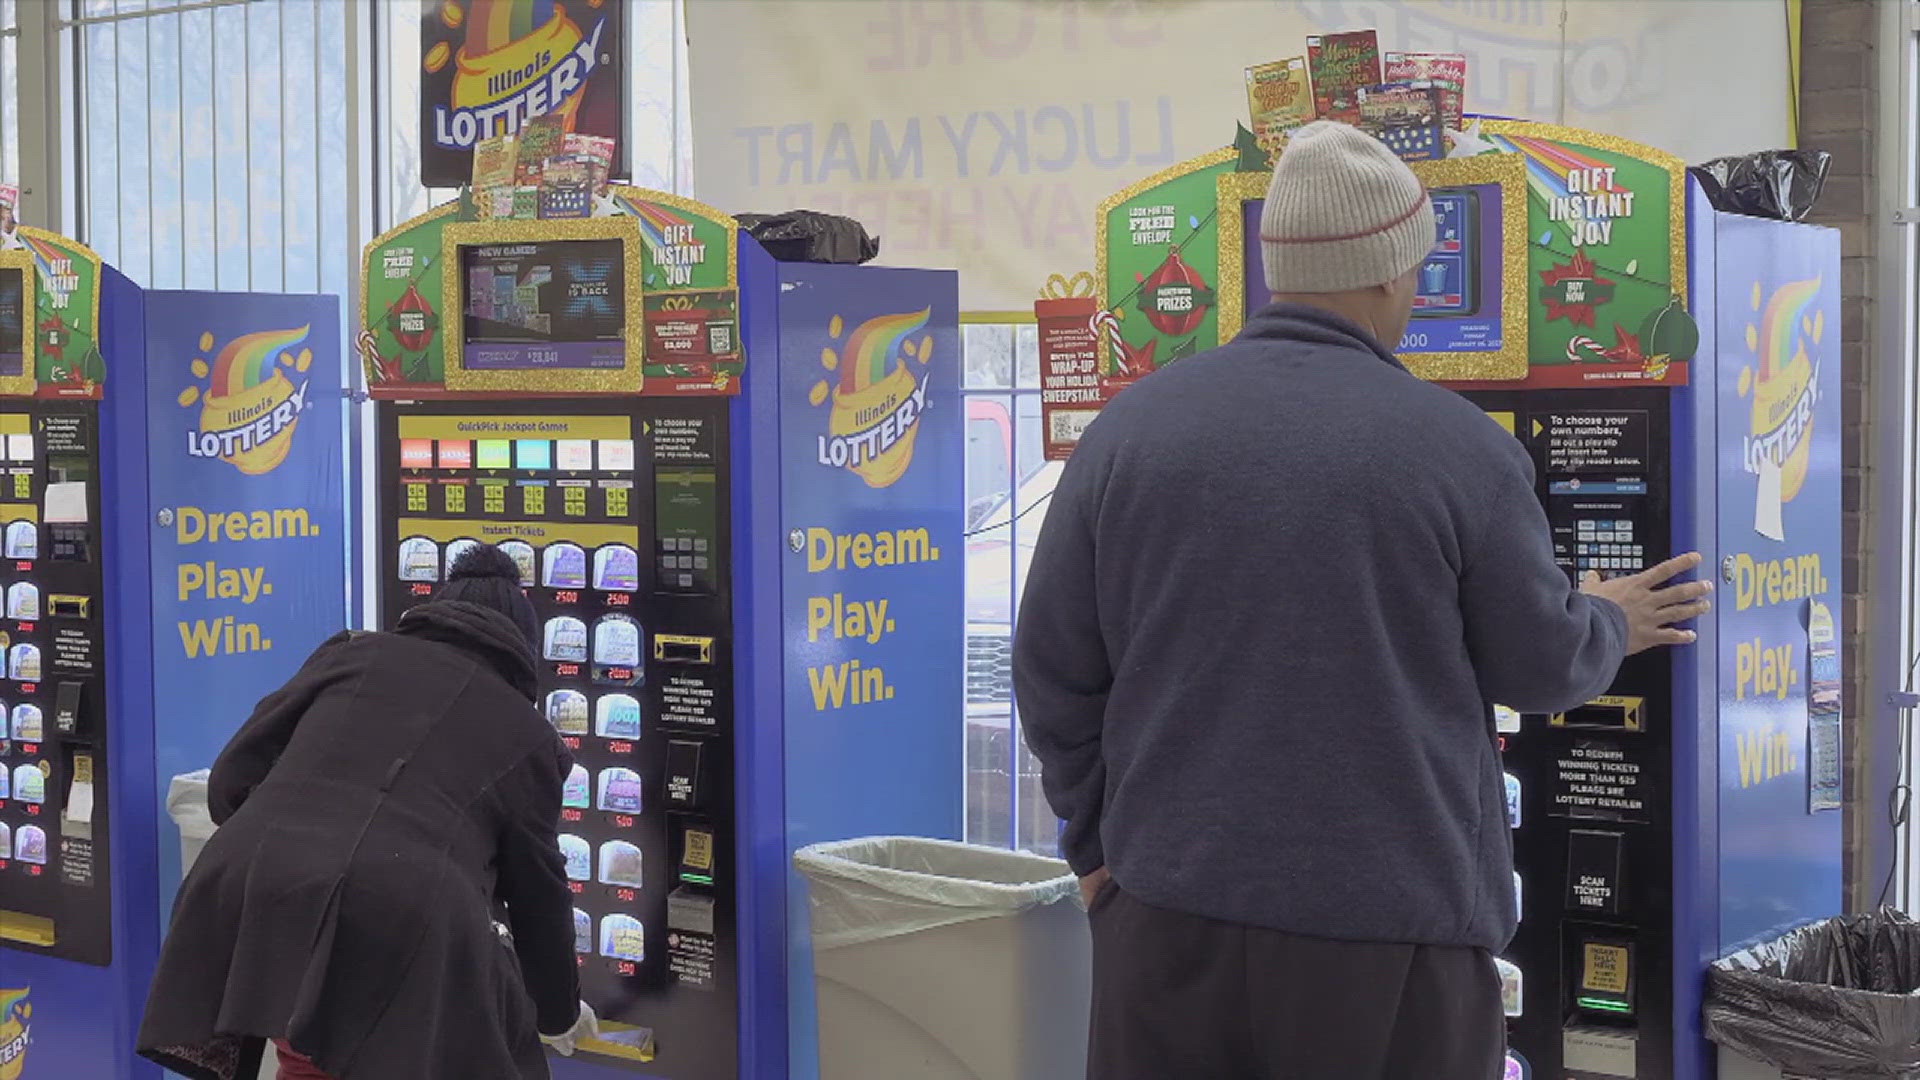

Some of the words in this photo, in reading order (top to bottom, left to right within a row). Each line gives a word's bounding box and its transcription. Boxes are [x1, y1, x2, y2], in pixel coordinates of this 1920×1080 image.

[435, 19, 606, 146] LOTTERY
[488, 49, 551, 97] Illinois
[1568, 166, 1616, 193] GIFT
[1550, 192, 1634, 221] INSTANT
[664, 224, 694, 245] GIFT
[1571, 220, 1613, 247] JOY
[653, 245, 706, 265] INSTANT
[666, 265, 693, 285] JOY
[1157, 296, 1192, 311] PRIZES
[1051, 360, 1094, 374] WRAP-UP
[1045, 376, 1065, 388] YOUR
[1066, 374, 1100, 387] HOLIDA
[855, 392, 897, 426] Illinois
[1042, 388, 1101, 403] SWEEPSTAKE
[187, 379, 309, 458] LOTTERY
[227, 396, 273, 424] Illinois
[817, 372, 930, 467] LOTTERY
[1551, 415, 1563, 425] To
[1565, 415, 1602, 425] choose
[1604, 416, 1628, 426] your
[1743, 355, 1821, 475] LOTTERY
[457, 422, 498, 432] QuickPick
[502, 421, 536, 432] Jackpot
[538, 422, 568, 432] Games
[1551, 427, 1572, 435] own
[1574, 426, 1622, 436] numbers,
[176, 506, 320, 544] Dream.
[482, 526, 512, 535] Instant
[514, 526, 545, 536] Tickets
[807, 527, 940, 573] Dream.
[178, 561, 273, 603] Play.
[1735, 553, 1827, 611] Dream.
[808, 593, 895, 644] Play.
[178, 616, 272, 658] Win.
[1736, 637, 1797, 701] Play.
[808, 659, 894, 711] Win.
[1558, 760, 1599, 770] WINNING
[1601, 763, 1640, 773] TICKETS
[1736, 722, 1797, 789] Win.
[1560, 772, 1586, 781] MORE
[1589, 774, 1616, 783] THAN
[1570, 785, 1605, 795] PLEASE
[1556, 795, 1597, 805] LOTTERY
[1598, 798, 1643, 809] RETAILER
[1574, 885, 1611, 897] TICKETS
[1580, 875, 1605, 887] SCAN
[1580, 896, 1604, 907] HERE
